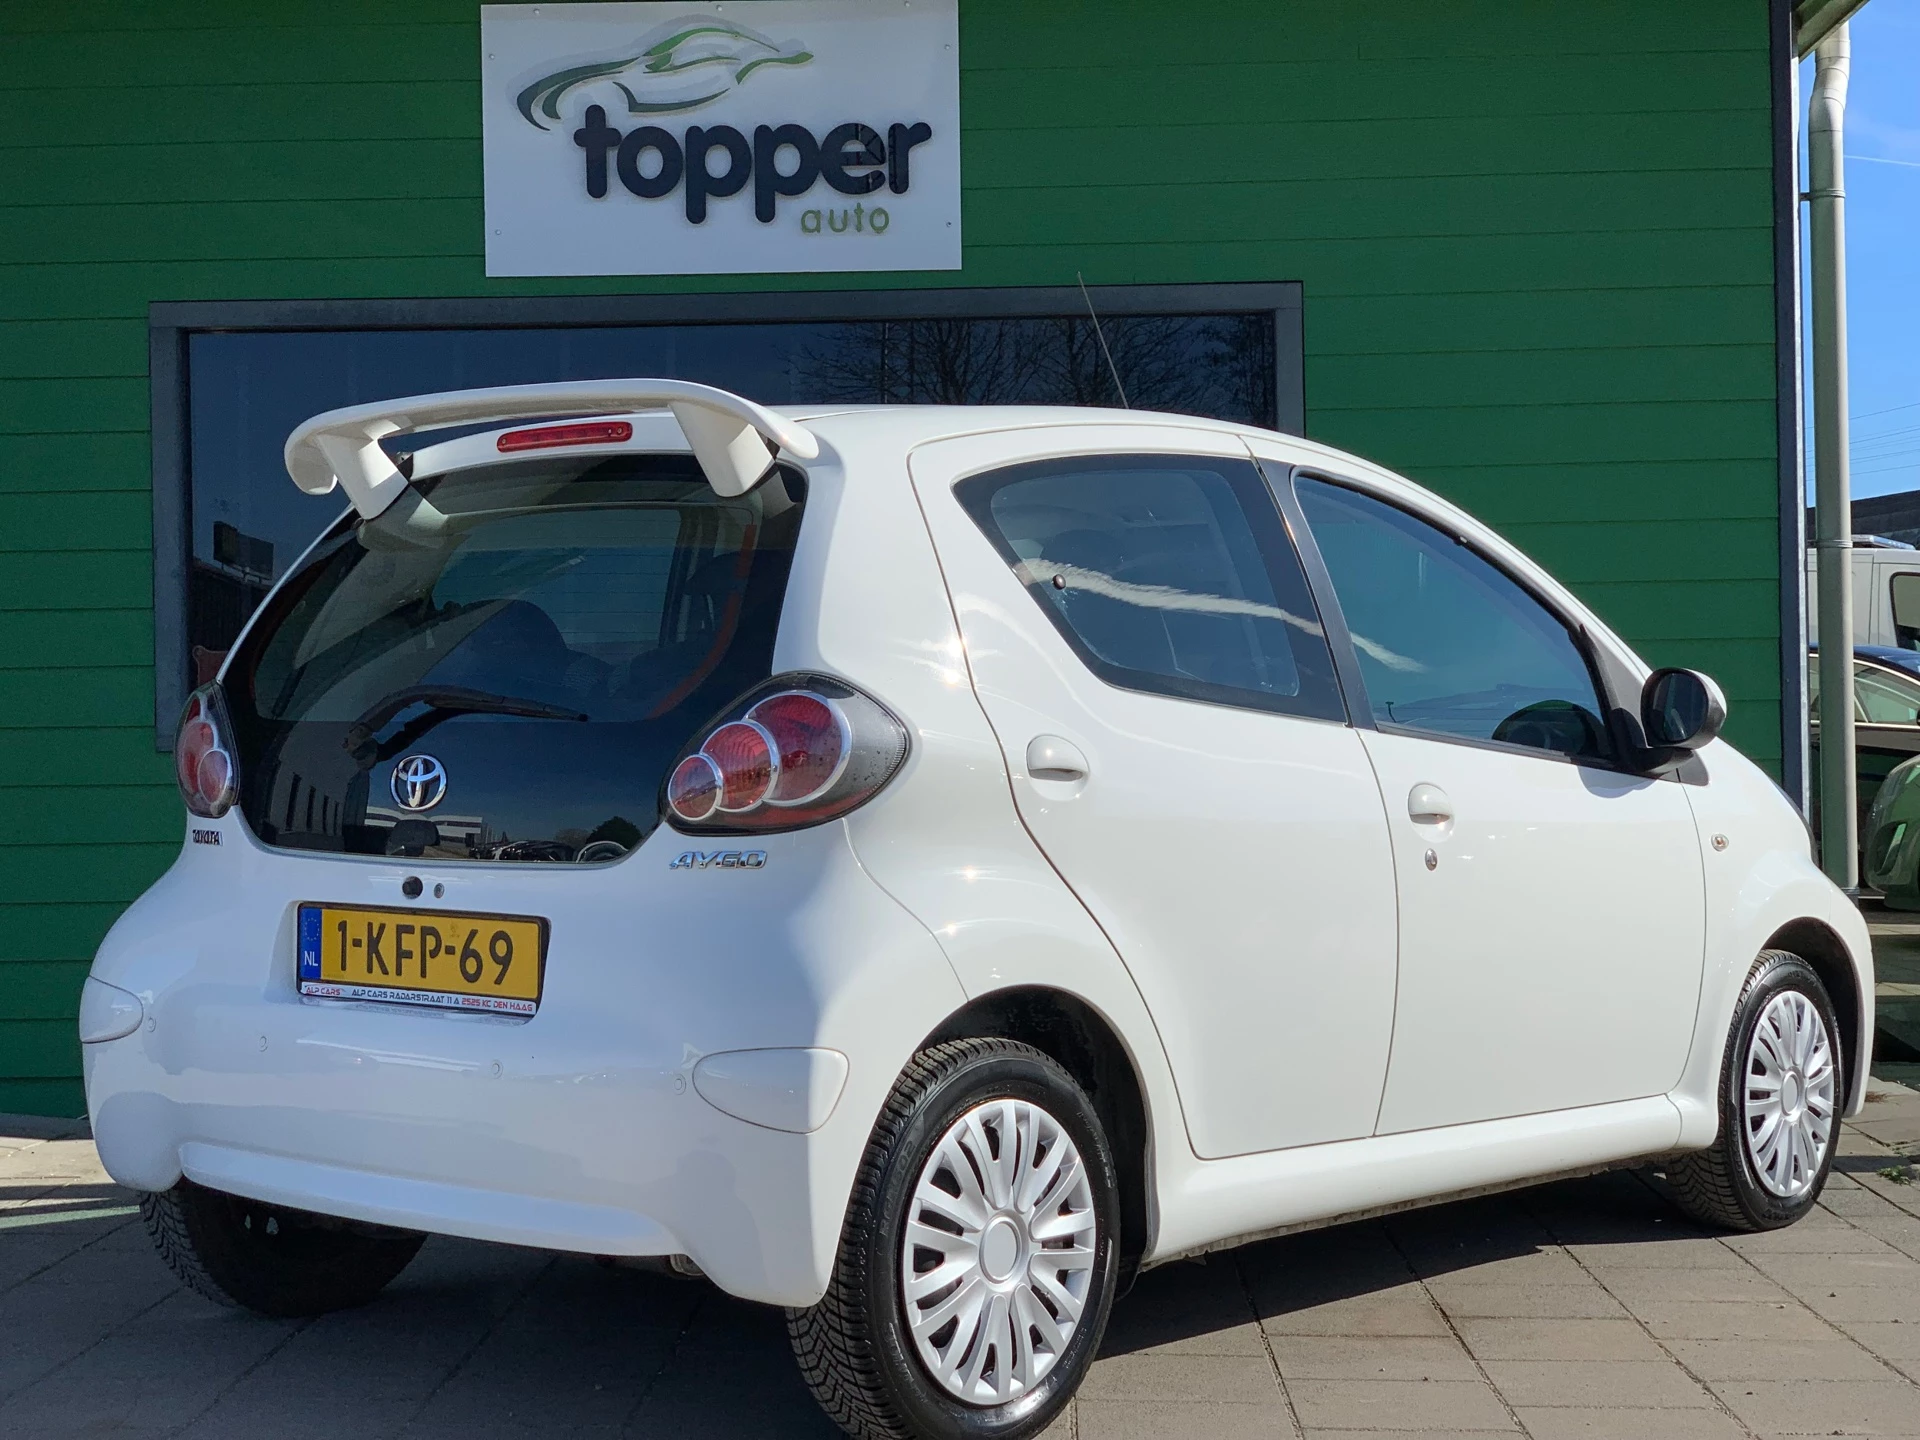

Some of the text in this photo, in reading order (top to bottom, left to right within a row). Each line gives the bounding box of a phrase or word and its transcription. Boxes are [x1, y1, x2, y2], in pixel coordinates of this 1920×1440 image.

[573, 104, 932, 225] topper
[800, 202, 890, 234] auto
[192, 829, 222, 846] TOYOTA
[669, 850, 768, 870] AYGO
[304, 950, 319, 967] NL
[337, 919, 514, 985] 1-KFP-69
[306, 986, 341, 996] ALP CARS
[352, 989, 366, 997] ALP
[367, 990, 388, 999] CARS
[389, 991, 445, 1004] RADARSTRAAT
[482, 999, 492, 1008] KC
[493, 1000, 508, 1010] DEN
[509, 1002, 533, 1012] HAAG
